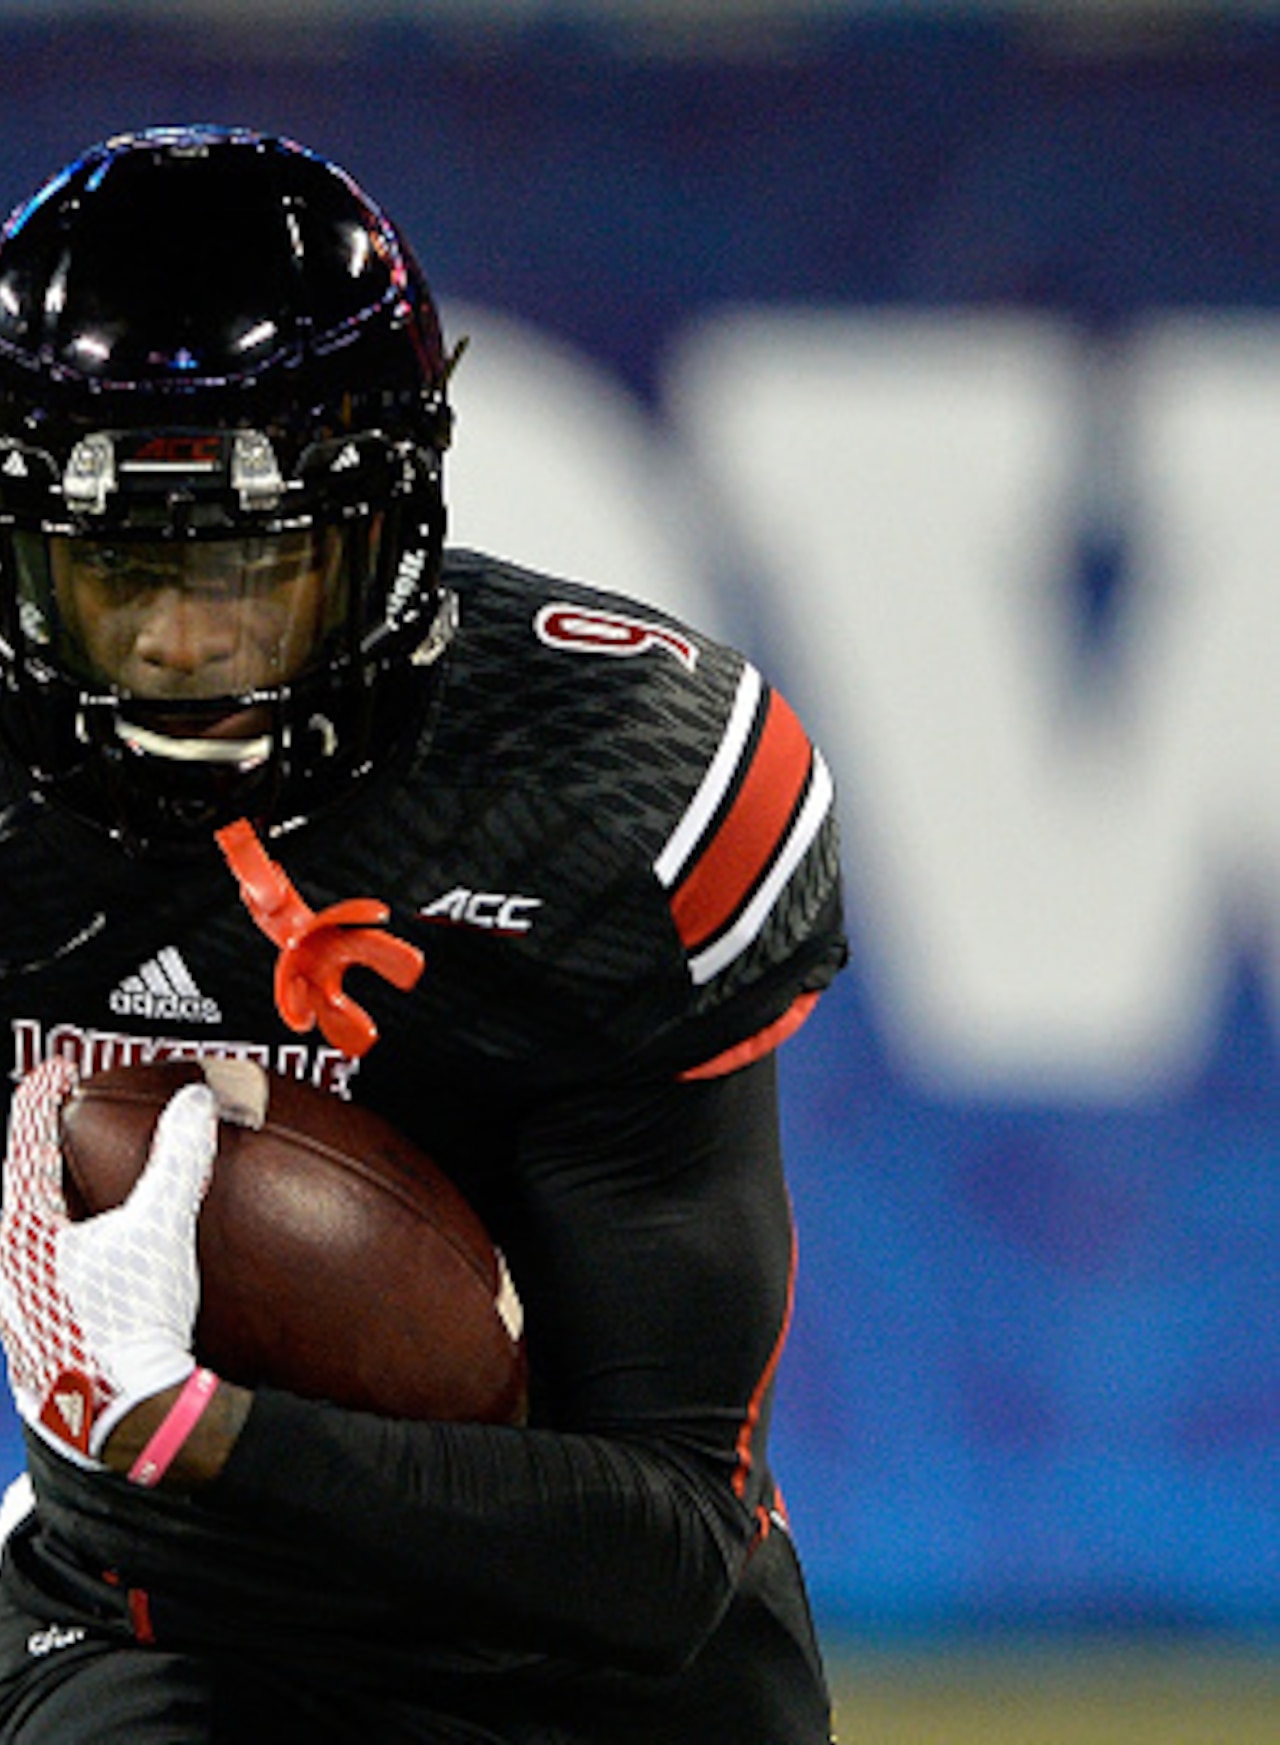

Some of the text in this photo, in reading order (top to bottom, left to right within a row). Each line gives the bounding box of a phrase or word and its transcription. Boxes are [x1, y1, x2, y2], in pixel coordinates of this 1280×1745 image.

[532, 602, 700, 674] 9
[418, 885, 545, 934] ACC
[109, 986, 222, 1023] adidas
